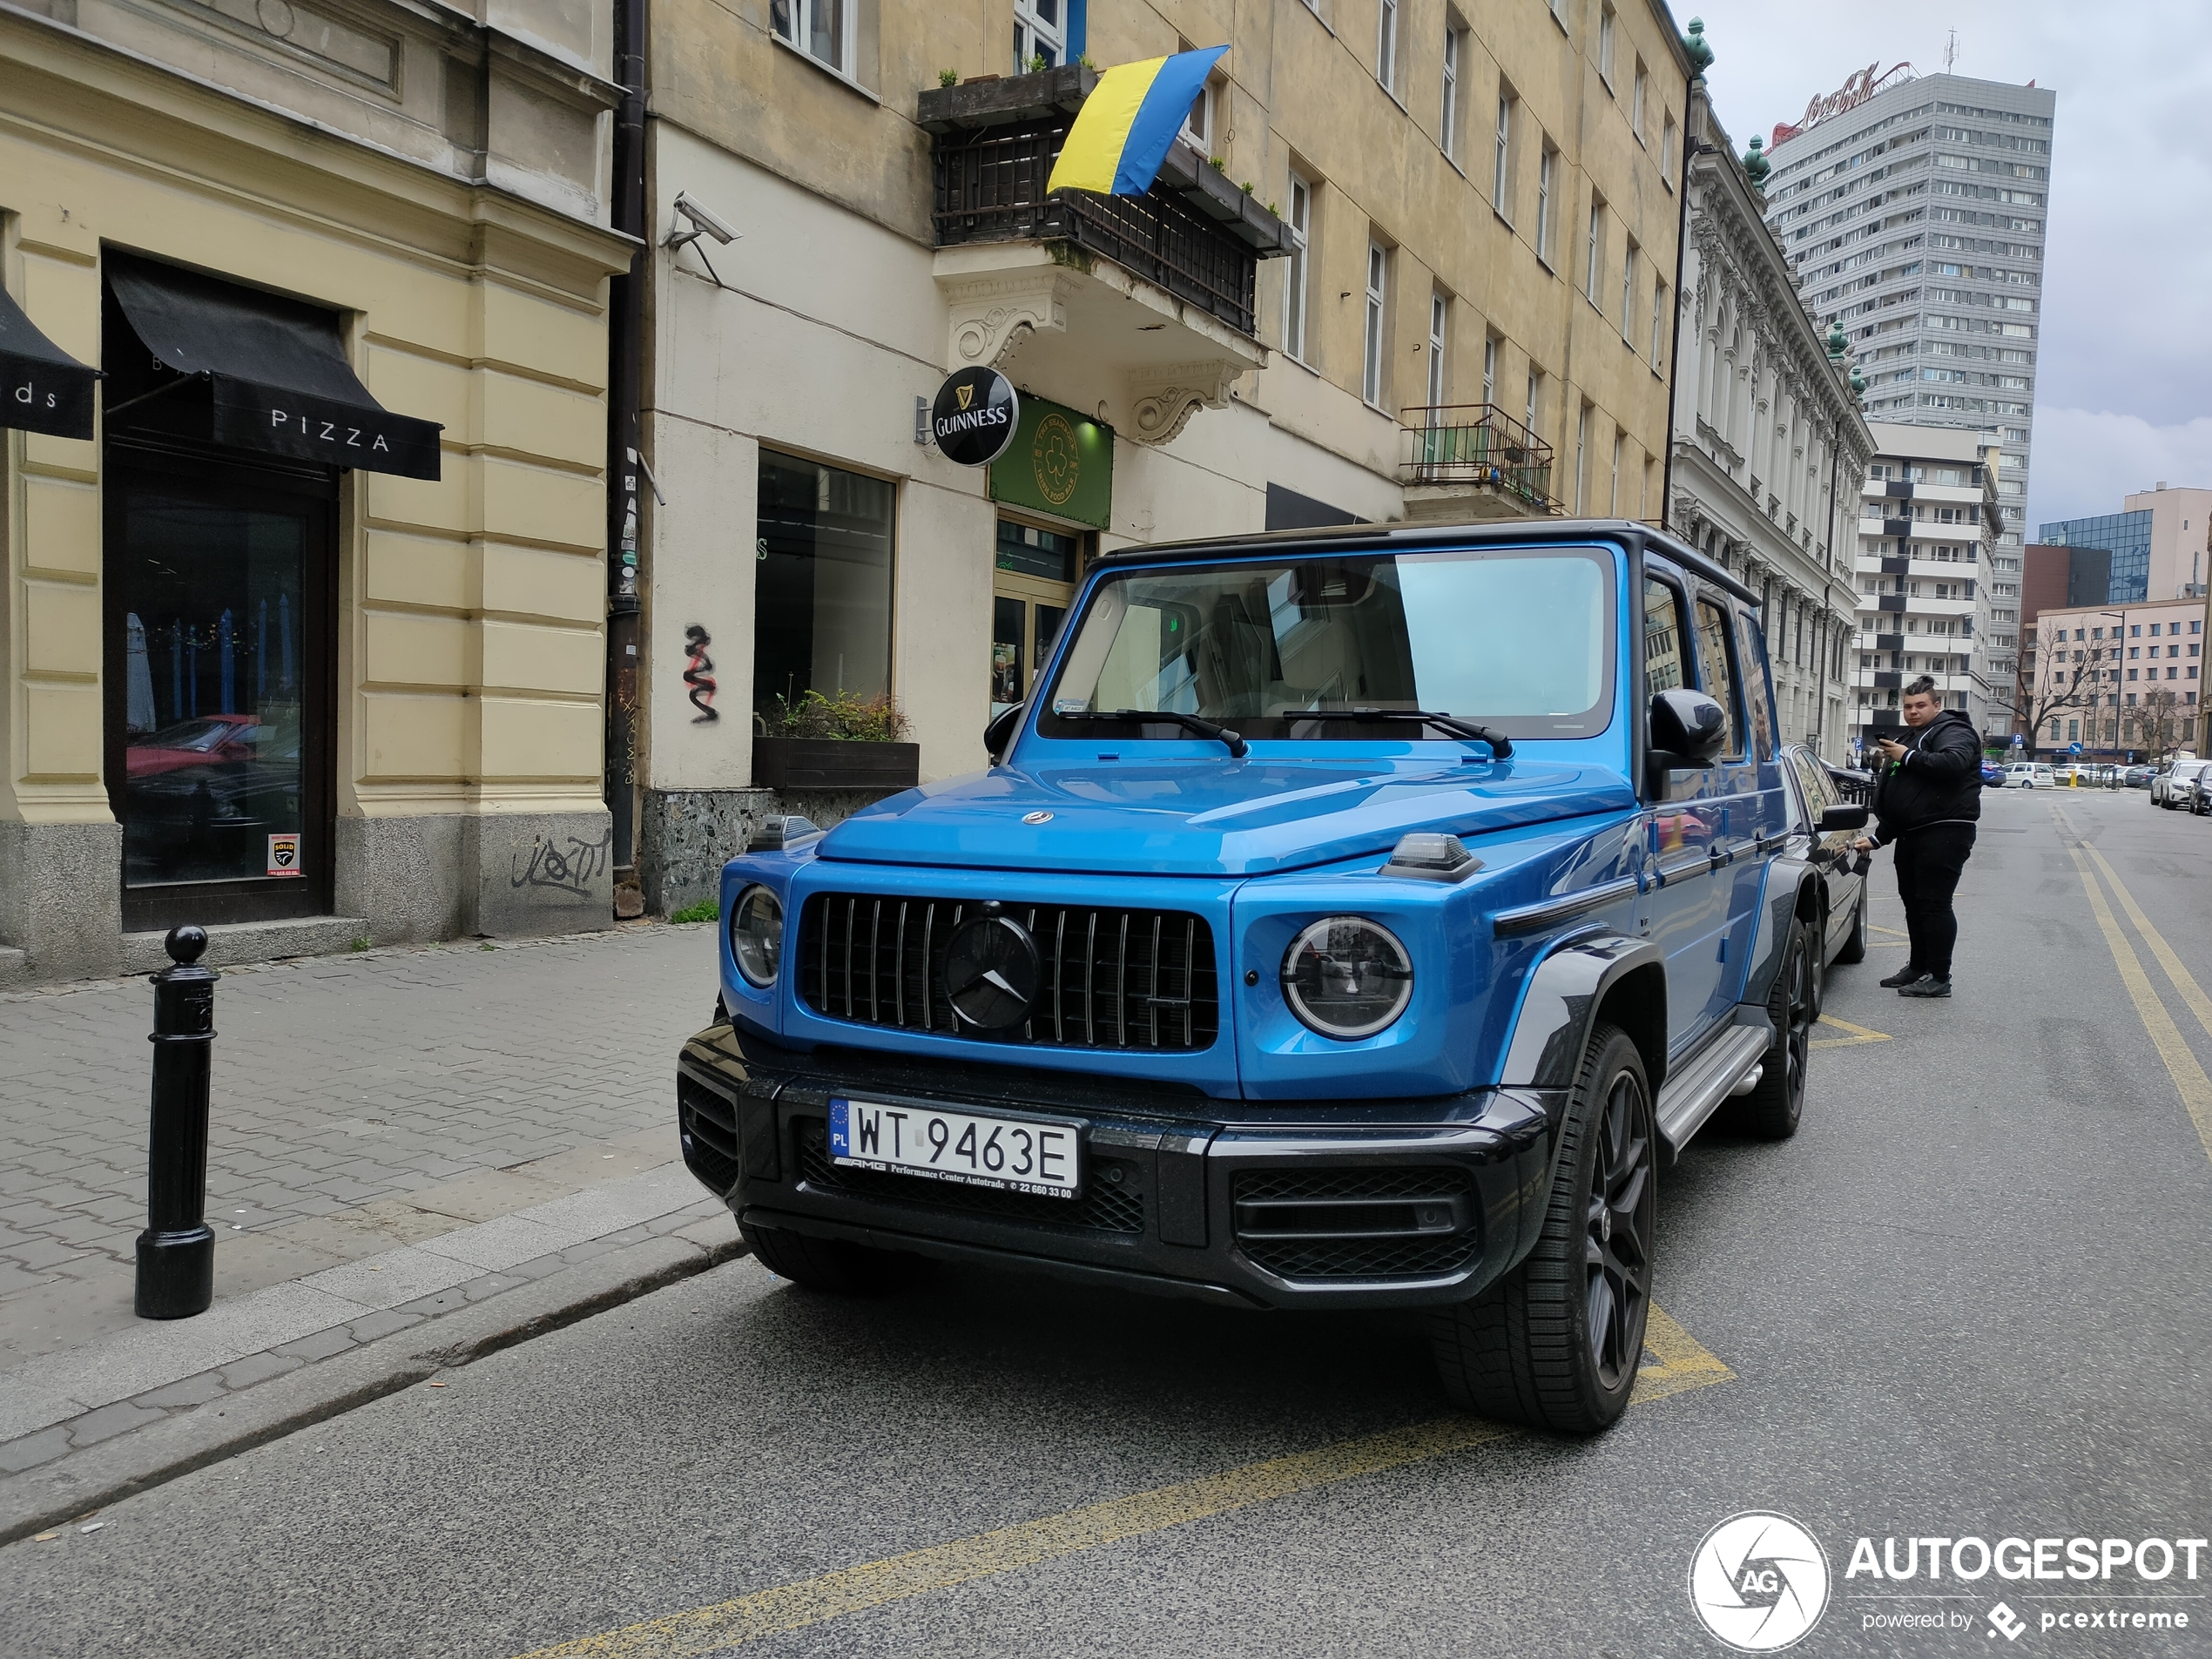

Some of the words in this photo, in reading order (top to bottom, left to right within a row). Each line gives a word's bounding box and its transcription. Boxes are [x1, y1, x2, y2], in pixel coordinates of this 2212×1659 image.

[272, 408, 389, 452] PIZZA
[935, 407, 1008, 437] GUINNESS
[1038, 422, 1049, 440] THE
[1049, 418, 1076, 451] SHAMROCK
[1037, 469, 1049, 494] IRISH
[1049, 492, 1065, 501] FOOD
[1065, 477, 1075, 495] BAR
[833, 1133, 847, 1147] PL
[858, 1107, 908, 1158] WT
[927, 1117, 1065, 1182] 9463E
[849, 1159, 887, 1171] AMG
[891, 1164, 938, 1179] Performance
[939, 1170, 965, 1184] Center
[966, 1176, 1005, 1189] Autotrade
[1019, 1183, 1030, 1193] 22
[1031, 1184, 1047, 1195] 660
[1049, 1187, 1060, 1197] 33
[1061, 1189, 1072, 1199] 00
